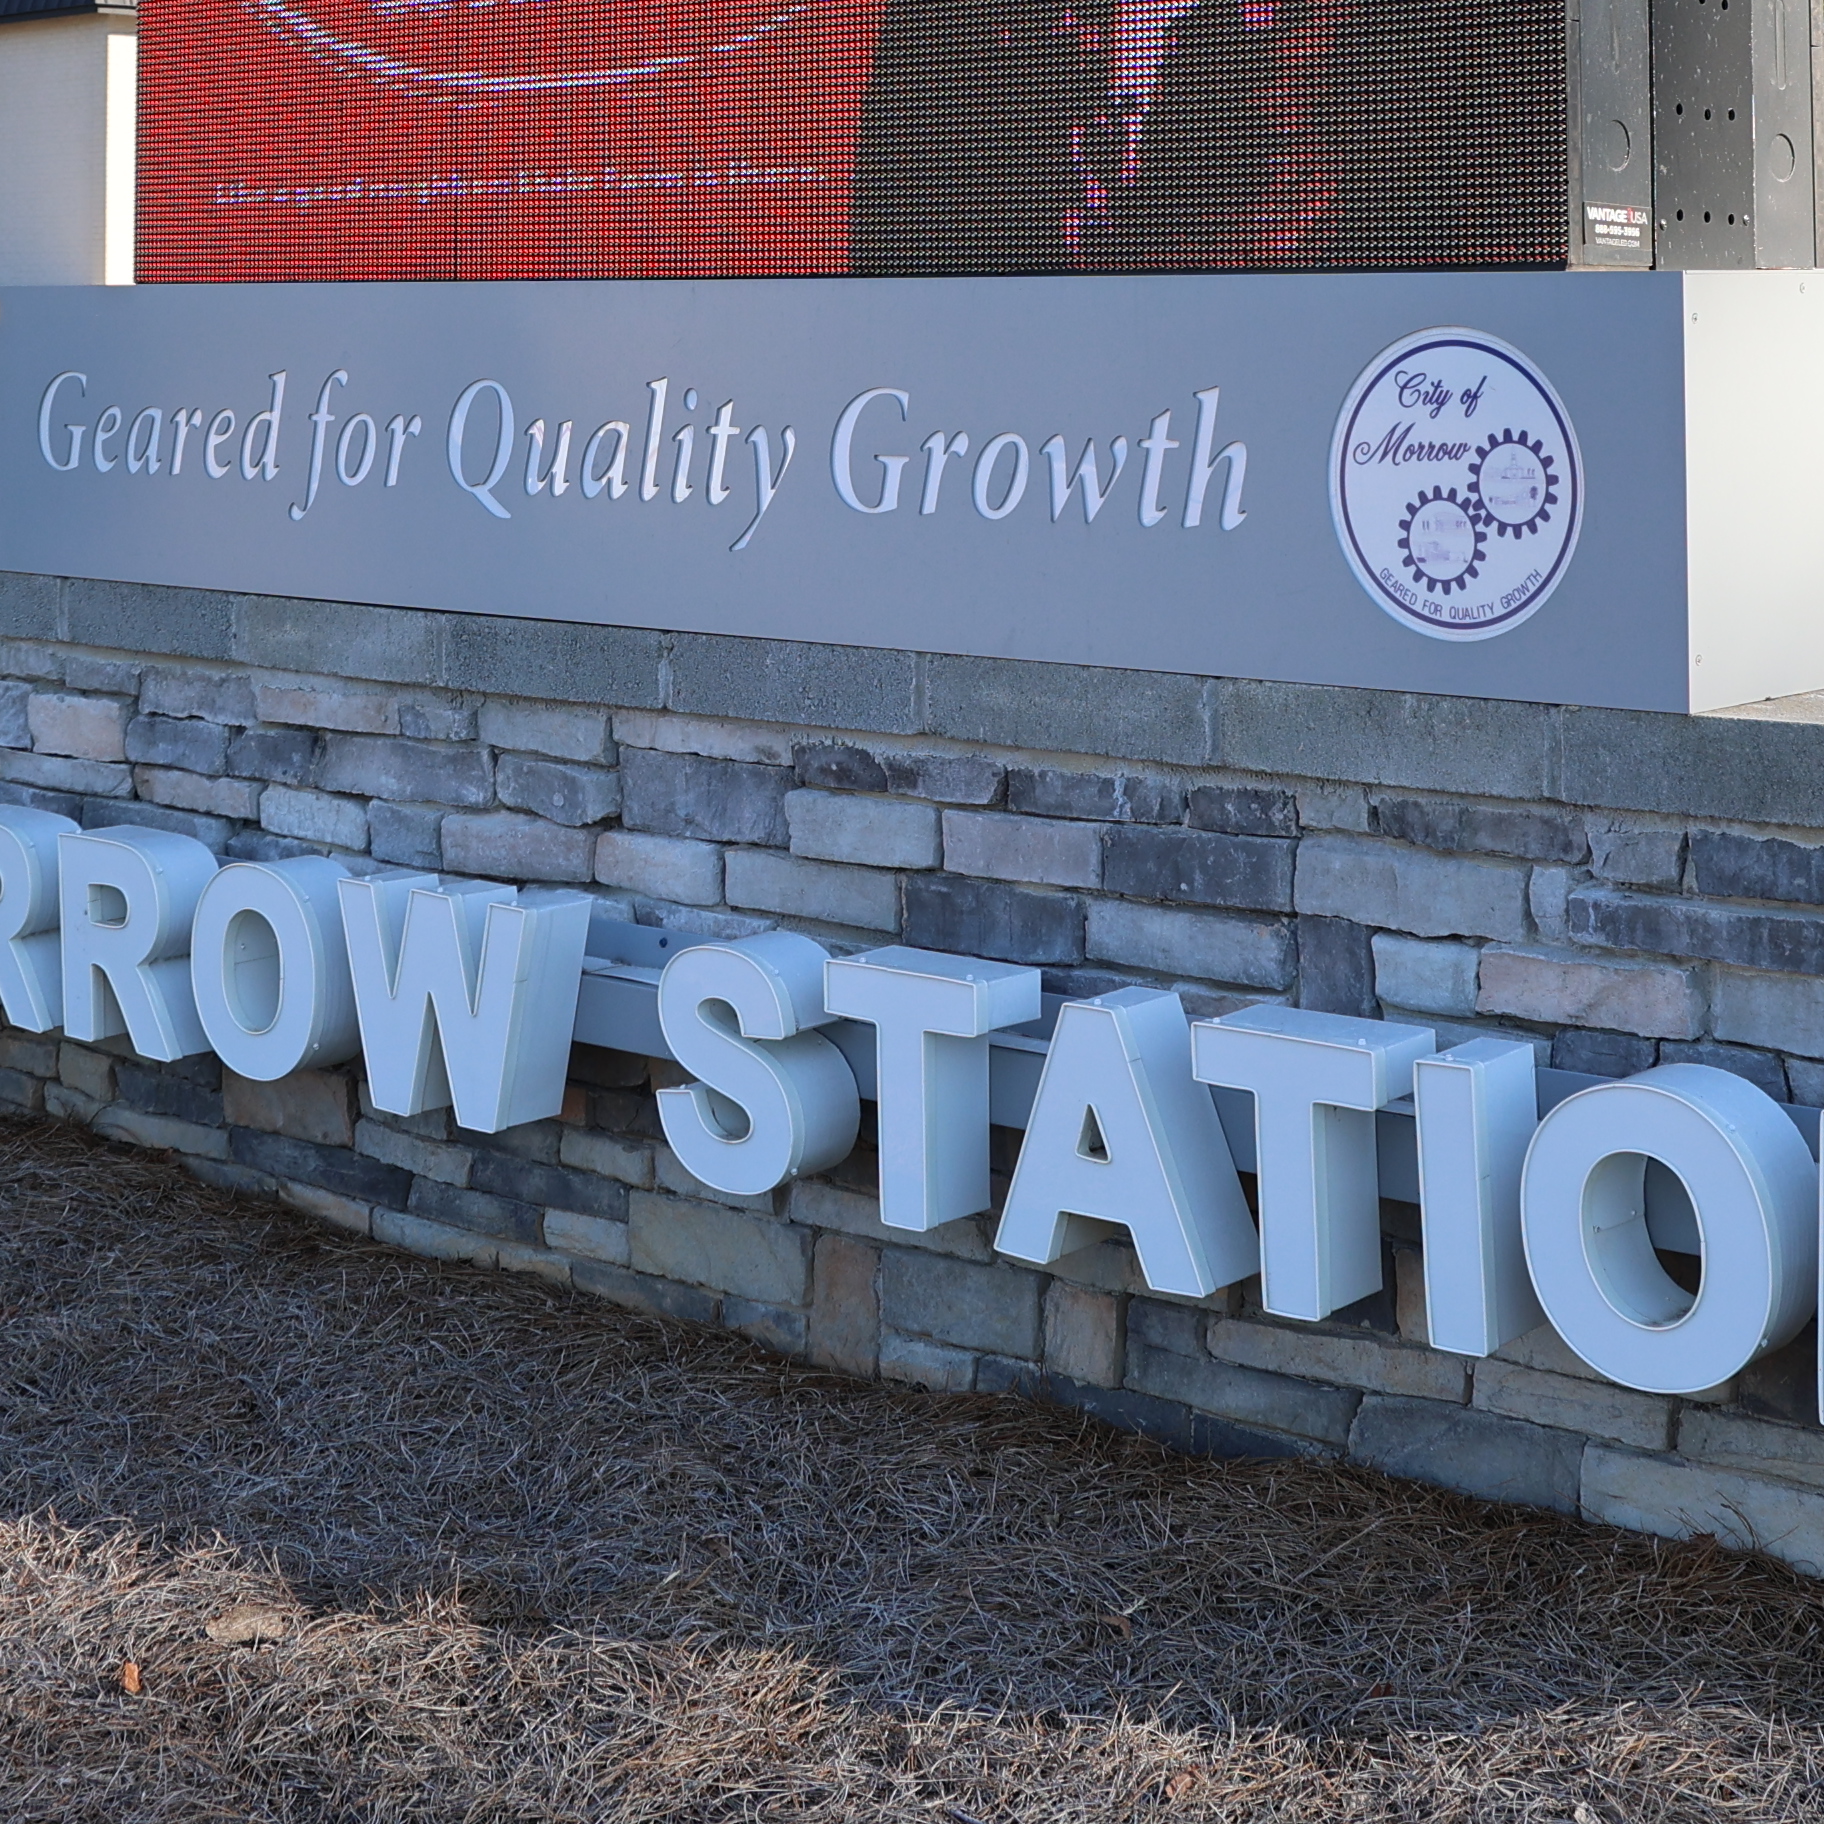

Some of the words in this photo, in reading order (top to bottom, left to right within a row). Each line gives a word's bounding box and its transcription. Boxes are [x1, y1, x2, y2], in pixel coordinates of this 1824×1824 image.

[1586, 206, 1628, 223] VANTAGE
[1631, 209, 1648, 225] USA
[1394, 370, 1453, 420] City
[1460, 375, 1488, 418] of
[38, 369, 287, 482] Geared
[289, 368, 422, 521] for
[446, 376, 796, 552] Quality
[830, 386, 1248, 532] Growth
[1353, 421, 1472, 467] Morrow
[1379, 567, 1419, 607] GEARED
[1422, 599, 1444, 618] FOR
[1449, 601, 1495, 621] QUALITY
[1500, 569, 1543, 609] GROWTH
